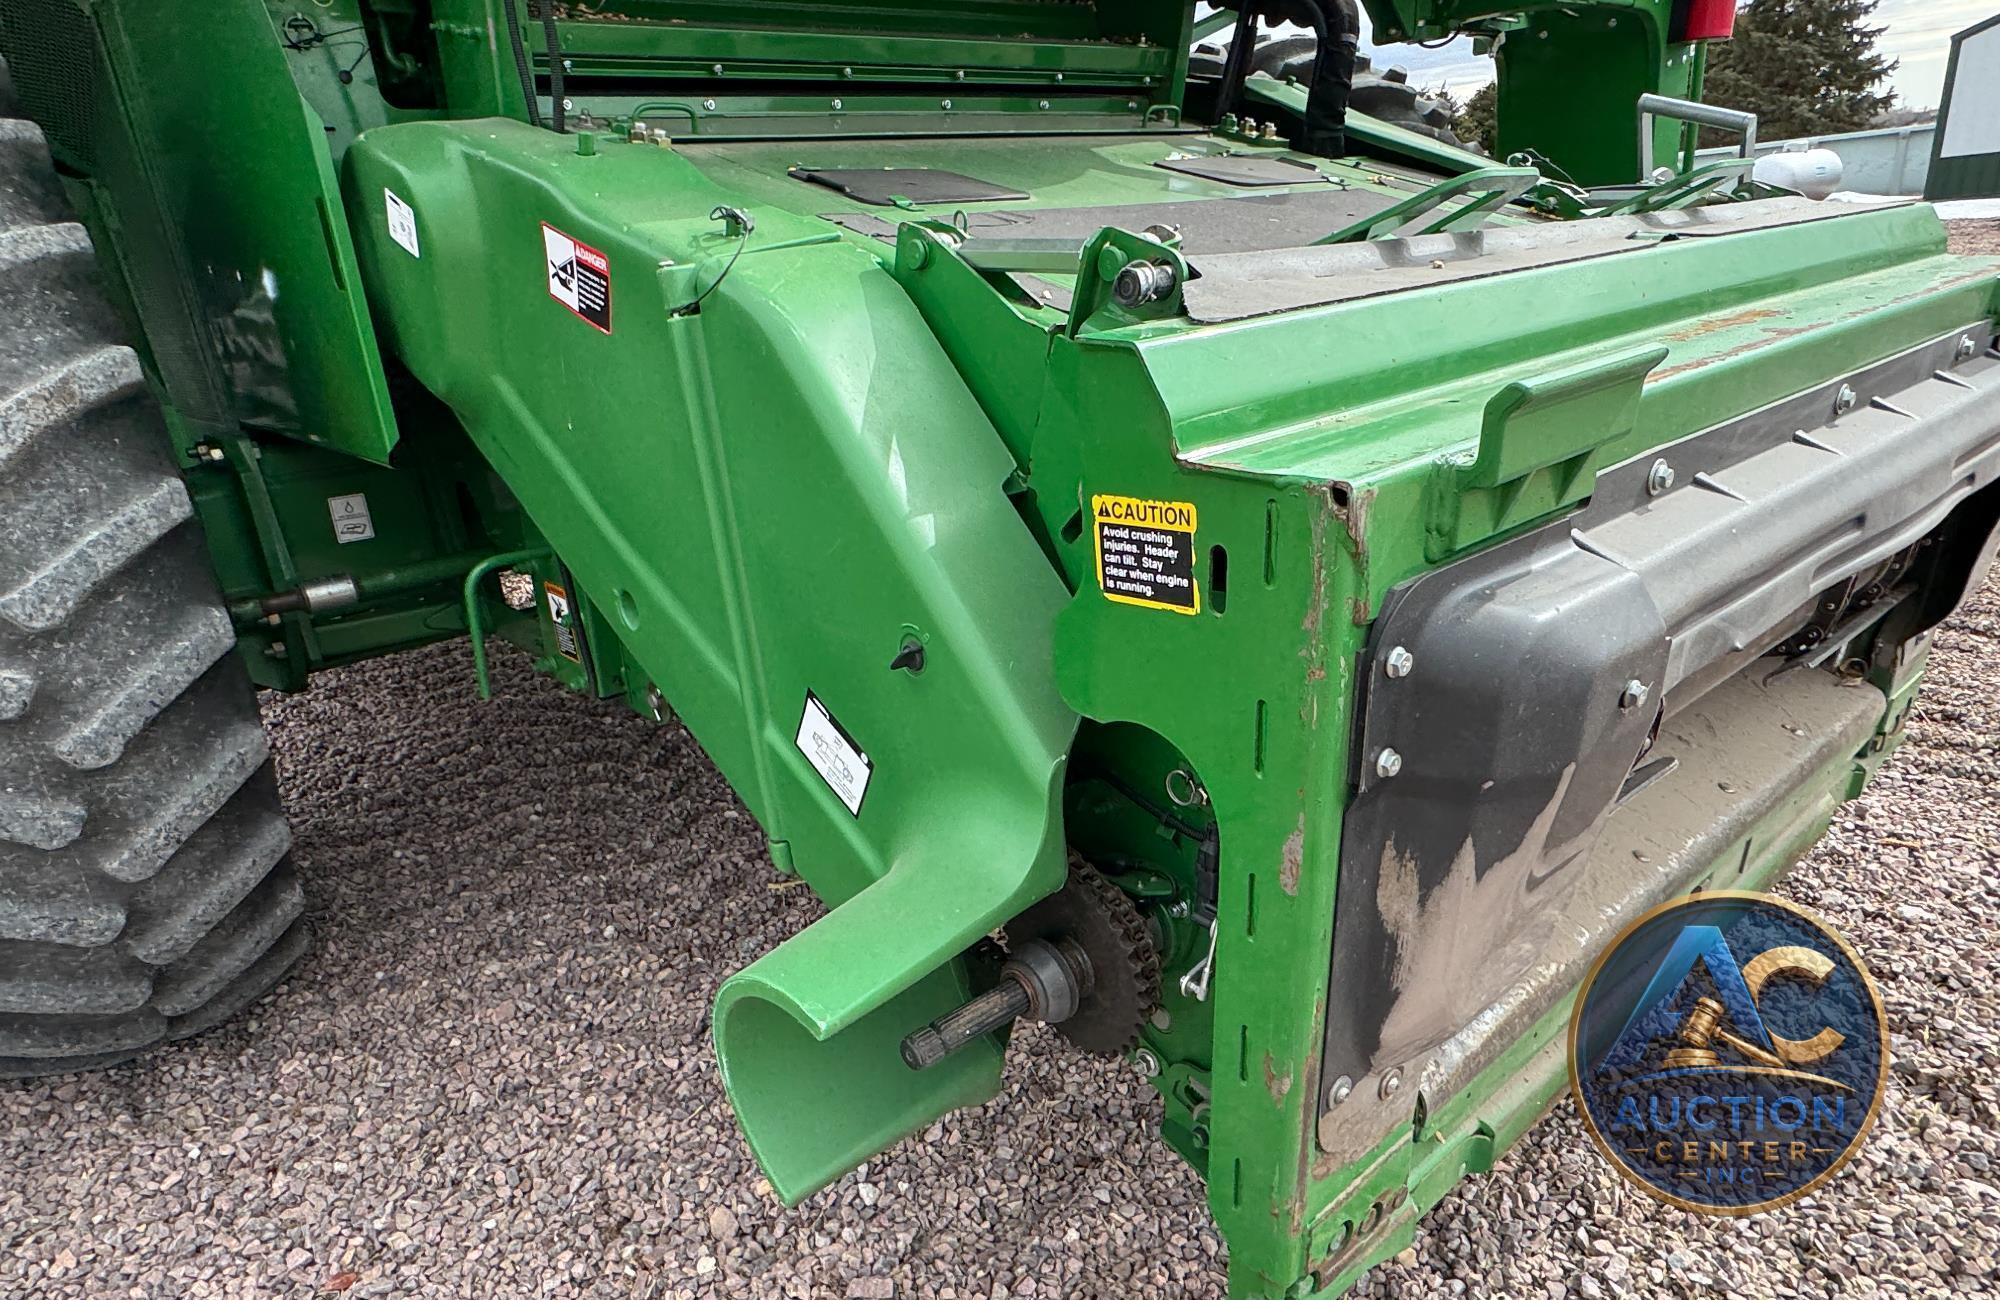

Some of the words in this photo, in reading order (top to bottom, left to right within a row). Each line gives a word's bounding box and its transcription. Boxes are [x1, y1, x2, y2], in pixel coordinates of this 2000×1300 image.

[1111, 501, 1191, 527] CAUTION
[1103, 525, 1129, 539] Avoid
[1131, 530, 1173, 547] crushing
[1103, 539, 1140, 553] injuries.
[1144, 543, 1179, 559] Header
[1104, 554, 1121, 564] can
[1122, 554, 1138, 566] tilt.
[1142, 556, 1164, 572] Stay
[1105, 565, 1128, 577] clear
[1129, 569, 1154, 582] when
[1155, 574, 1189, 587] engine
[1106, 577, 1115, 588] is
[1116, 580, 1155, 597] running.
